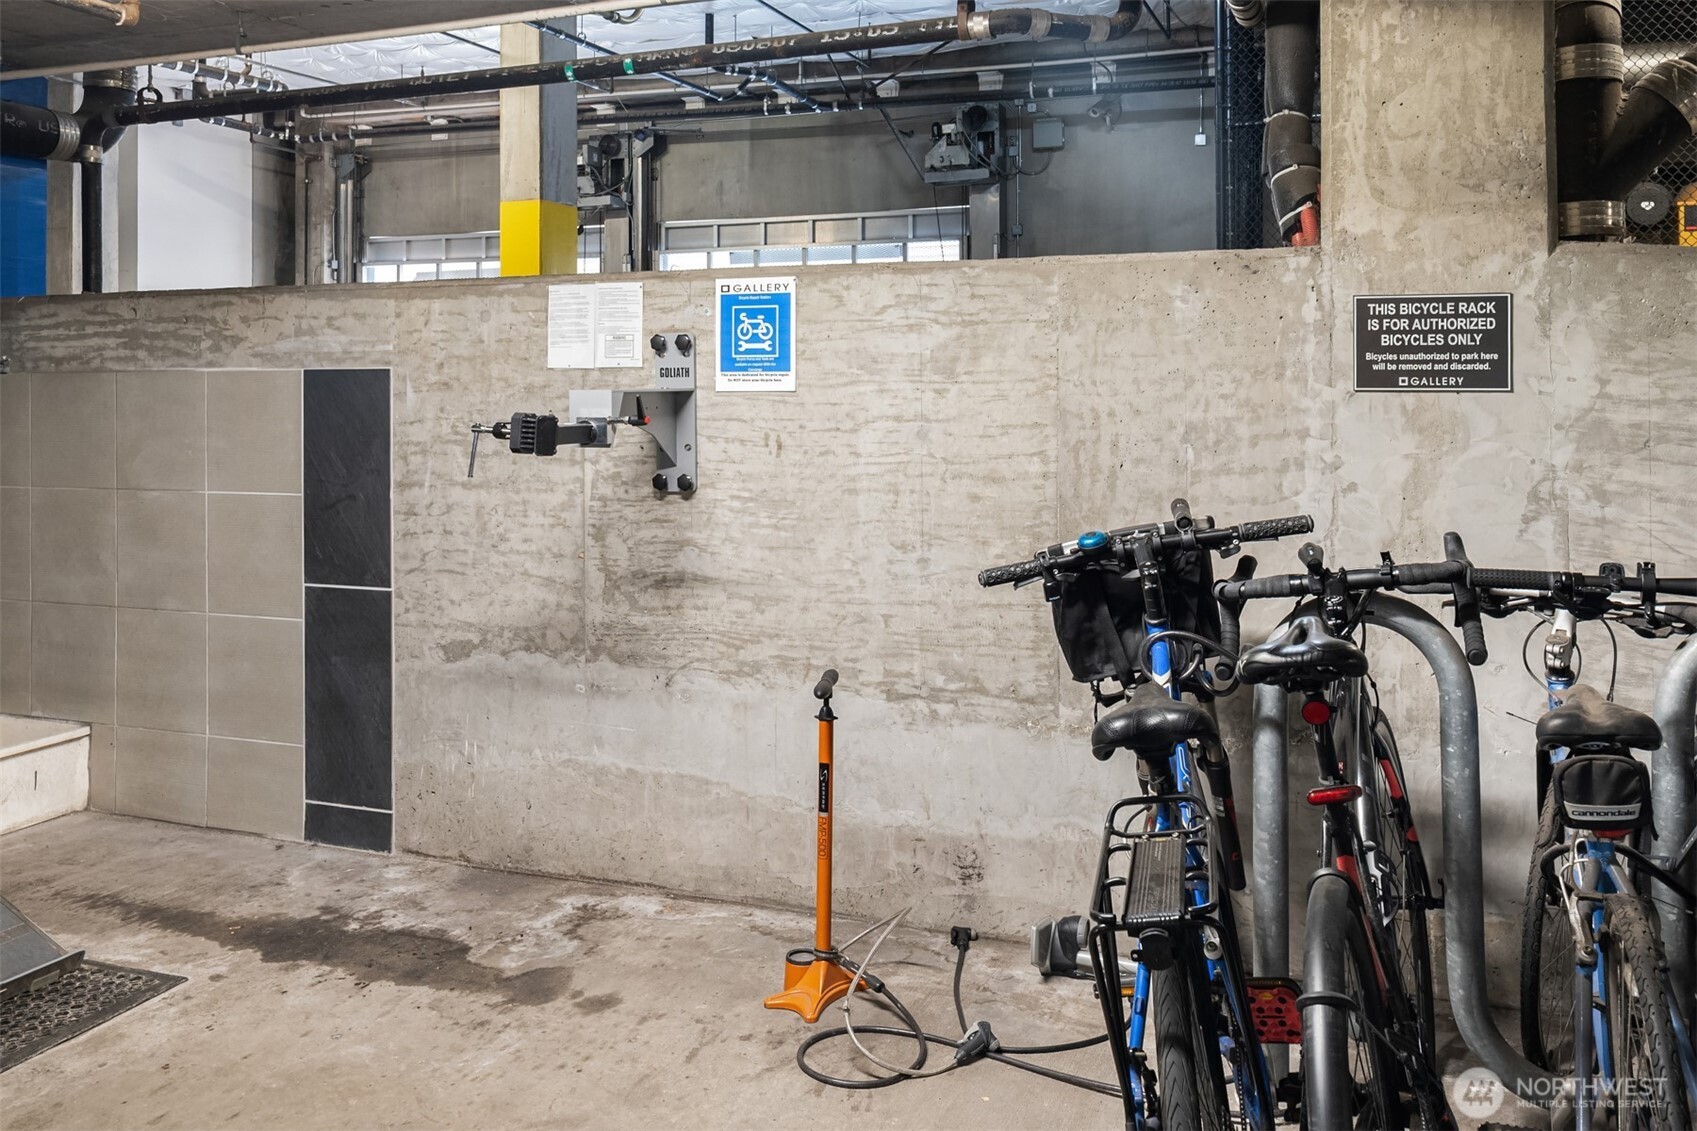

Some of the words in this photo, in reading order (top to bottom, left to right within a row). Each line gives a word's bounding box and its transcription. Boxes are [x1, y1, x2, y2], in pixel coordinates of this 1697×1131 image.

[733, 283, 790, 292] GALLERY
[1367, 303, 1396, 315] THIS
[1399, 302, 1455, 315] BICYCLE
[1458, 301, 1496, 314] RACK
[1367, 319, 1380, 331] IS
[1383, 318, 1409, 331] FOR
[1412, 317, 1496, 331] AUTHORIZED
[1381, 333, 1445, 346] BICYCLES
[1447, 333, 1483, 346] ONLY
[1365, 352, 1398, 361] Bicycles
[1399, 352, 1450, 361] unauthorized
[1461, 352, 1479, 362] park
[1480, 352, 1499, 360] here
[1372, 363, 1386, 371] will
[1387, 363, 1397, 371] be
[1398, 363, 1432, 371] removed
[1433, 363, 1449, 371] and
[1450, 362, 1491, 371] discarded.
[659, 367, 690, 378] GOLIATH
[1410, 376, 1464, 386] GALLERY
[1571, 809, 1636, 817] cannondale
